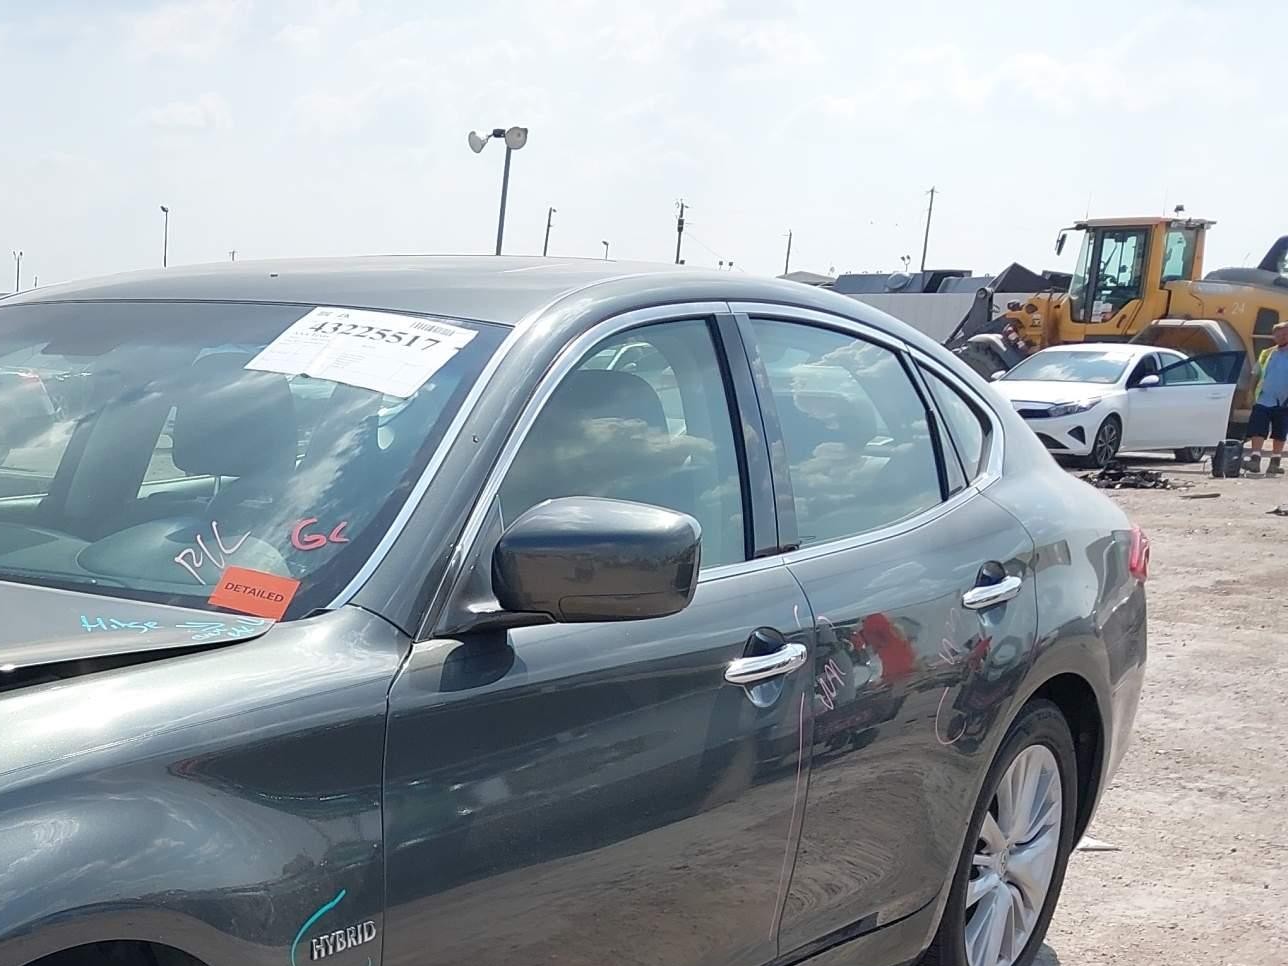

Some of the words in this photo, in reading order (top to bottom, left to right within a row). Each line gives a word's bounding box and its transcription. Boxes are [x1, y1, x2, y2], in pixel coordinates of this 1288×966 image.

[309, 321, 441, 351] 43225517
[223, 581, 285, 603] DETAILED
[311, 920, 377, 961] HYBRID
